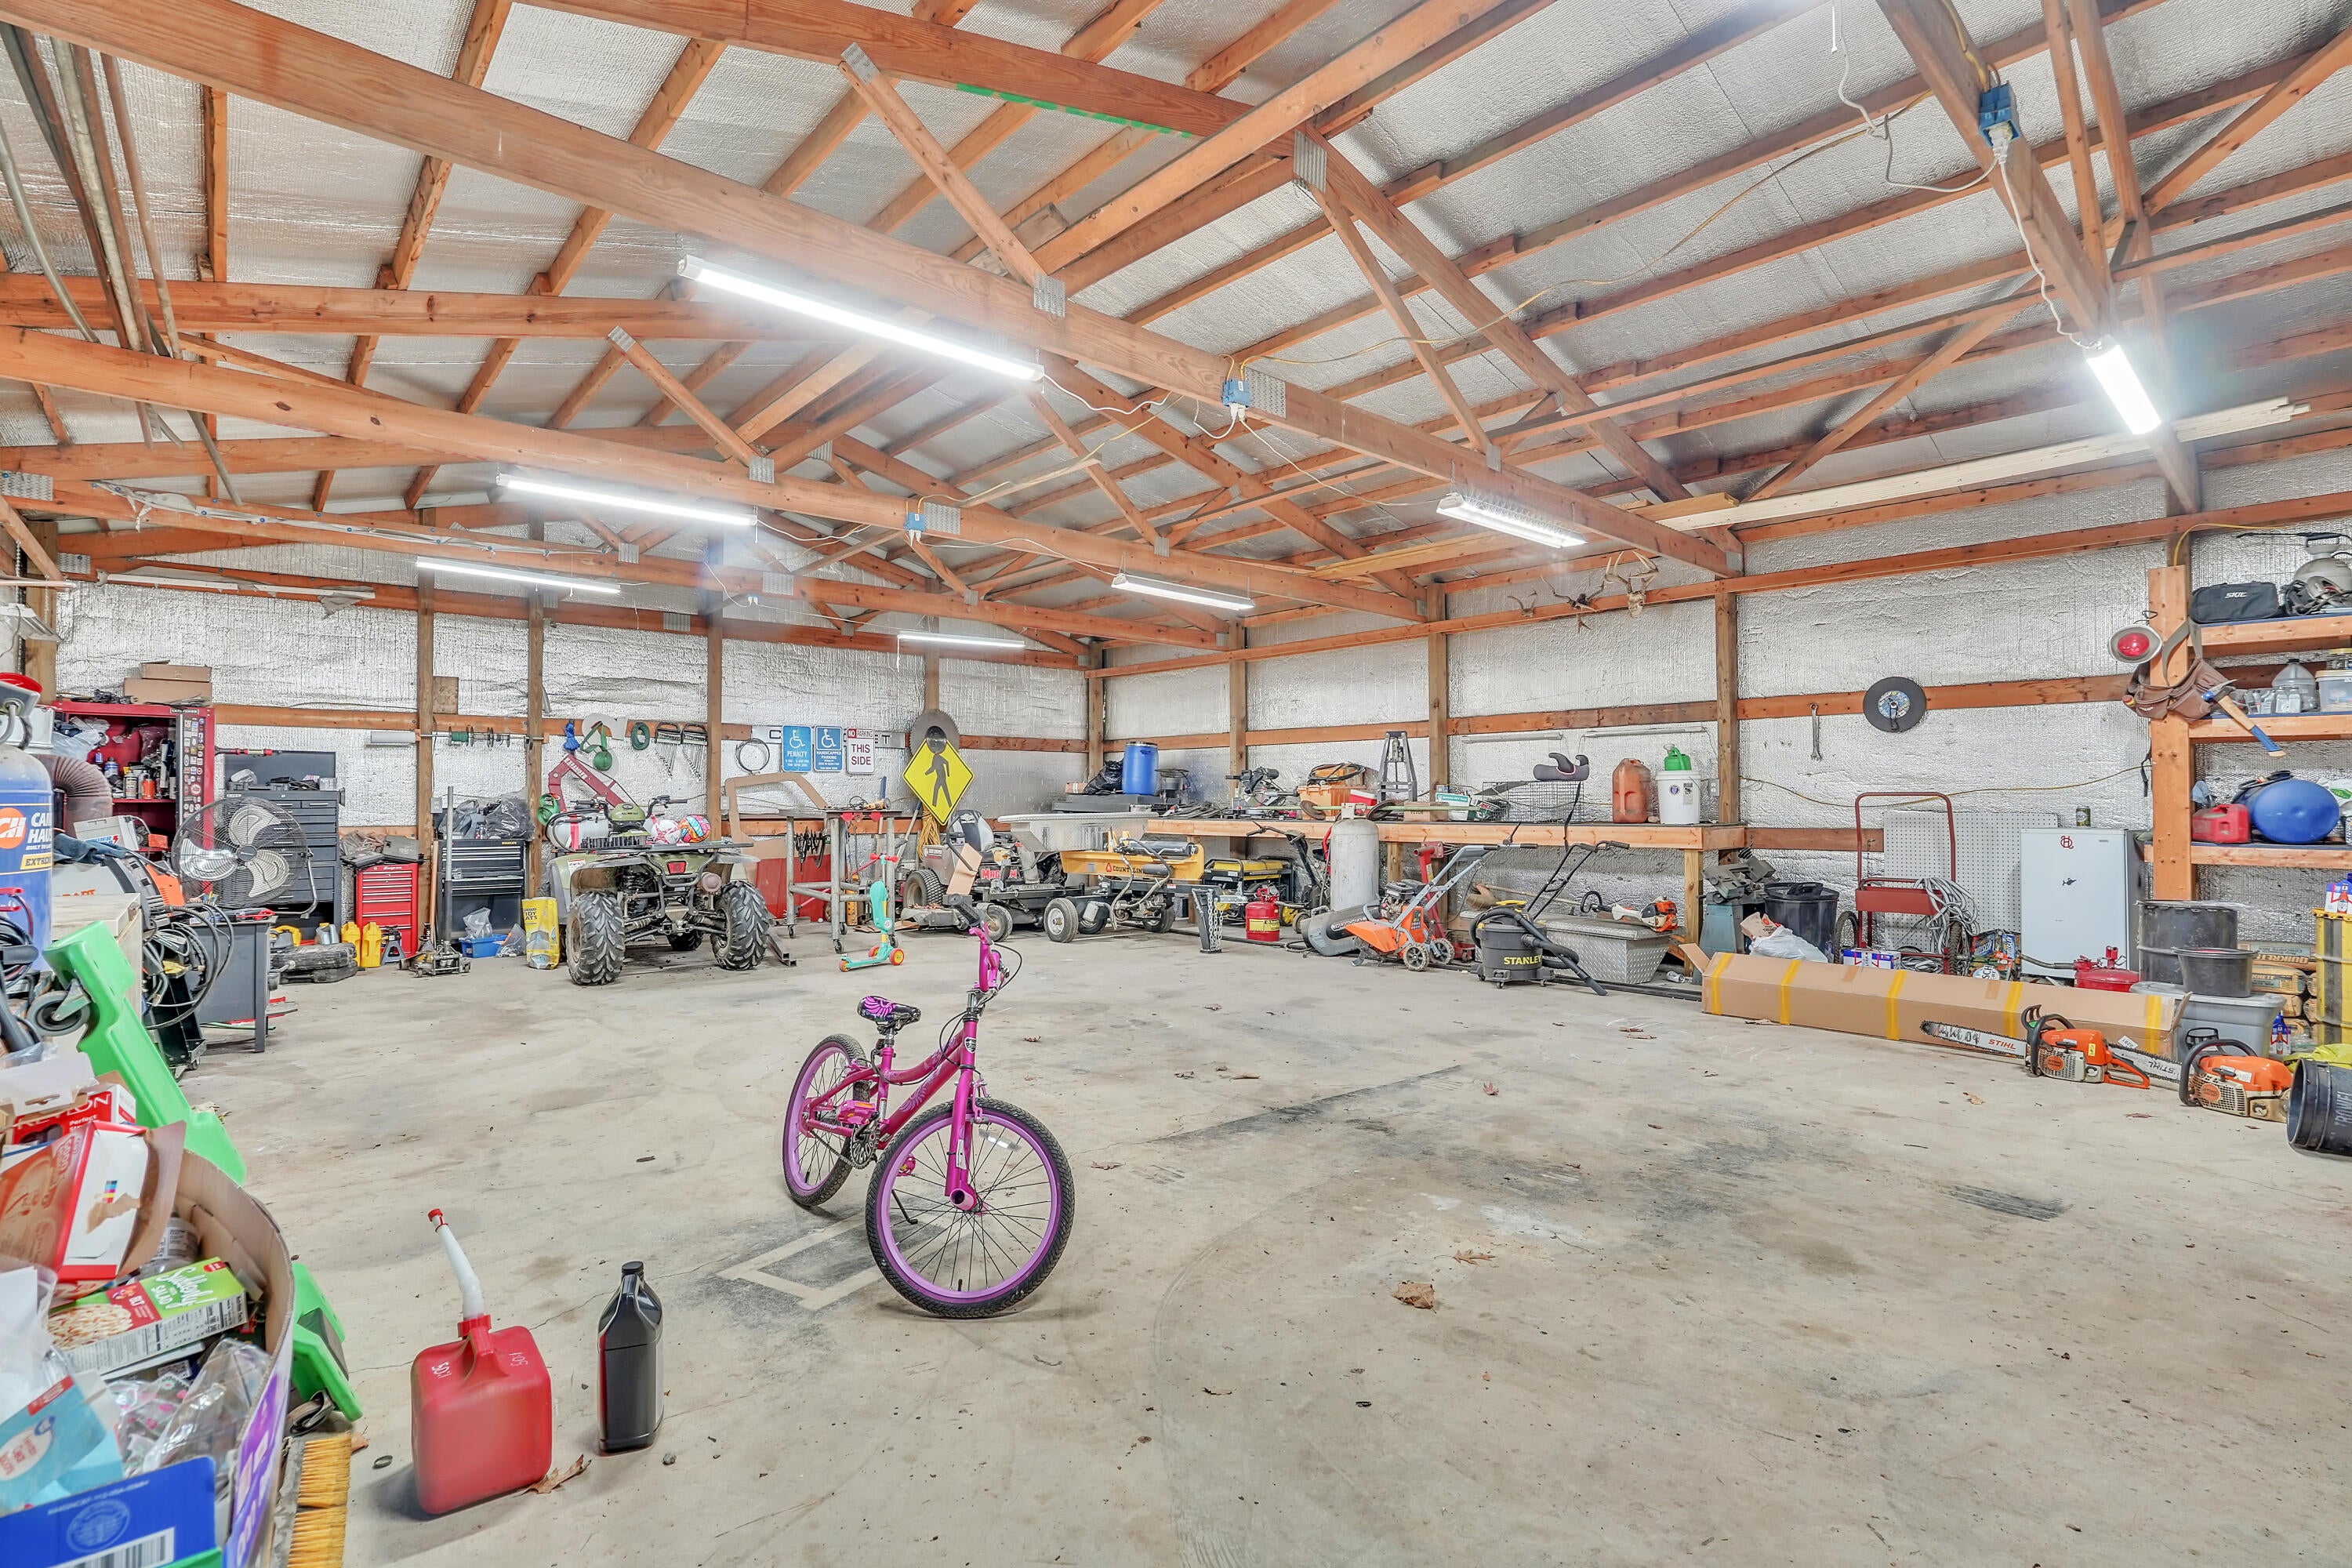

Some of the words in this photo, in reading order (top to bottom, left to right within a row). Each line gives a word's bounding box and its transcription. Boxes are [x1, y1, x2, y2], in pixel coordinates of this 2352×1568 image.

[851, 744, 870, 753] THIS
[851, 756, 871, 765] SIDE
[982, 868, 1018, 880] MAGM
[1112, 866, 1145, 874] COUNTLIN
[1504, 954, 1542, 965] STANLEY
[1988, 1039, 2016, 1050] STIHL
[2148, 1061, 2175, 1074] STIHL
[69, 1115, 97, 1127] Perfect
